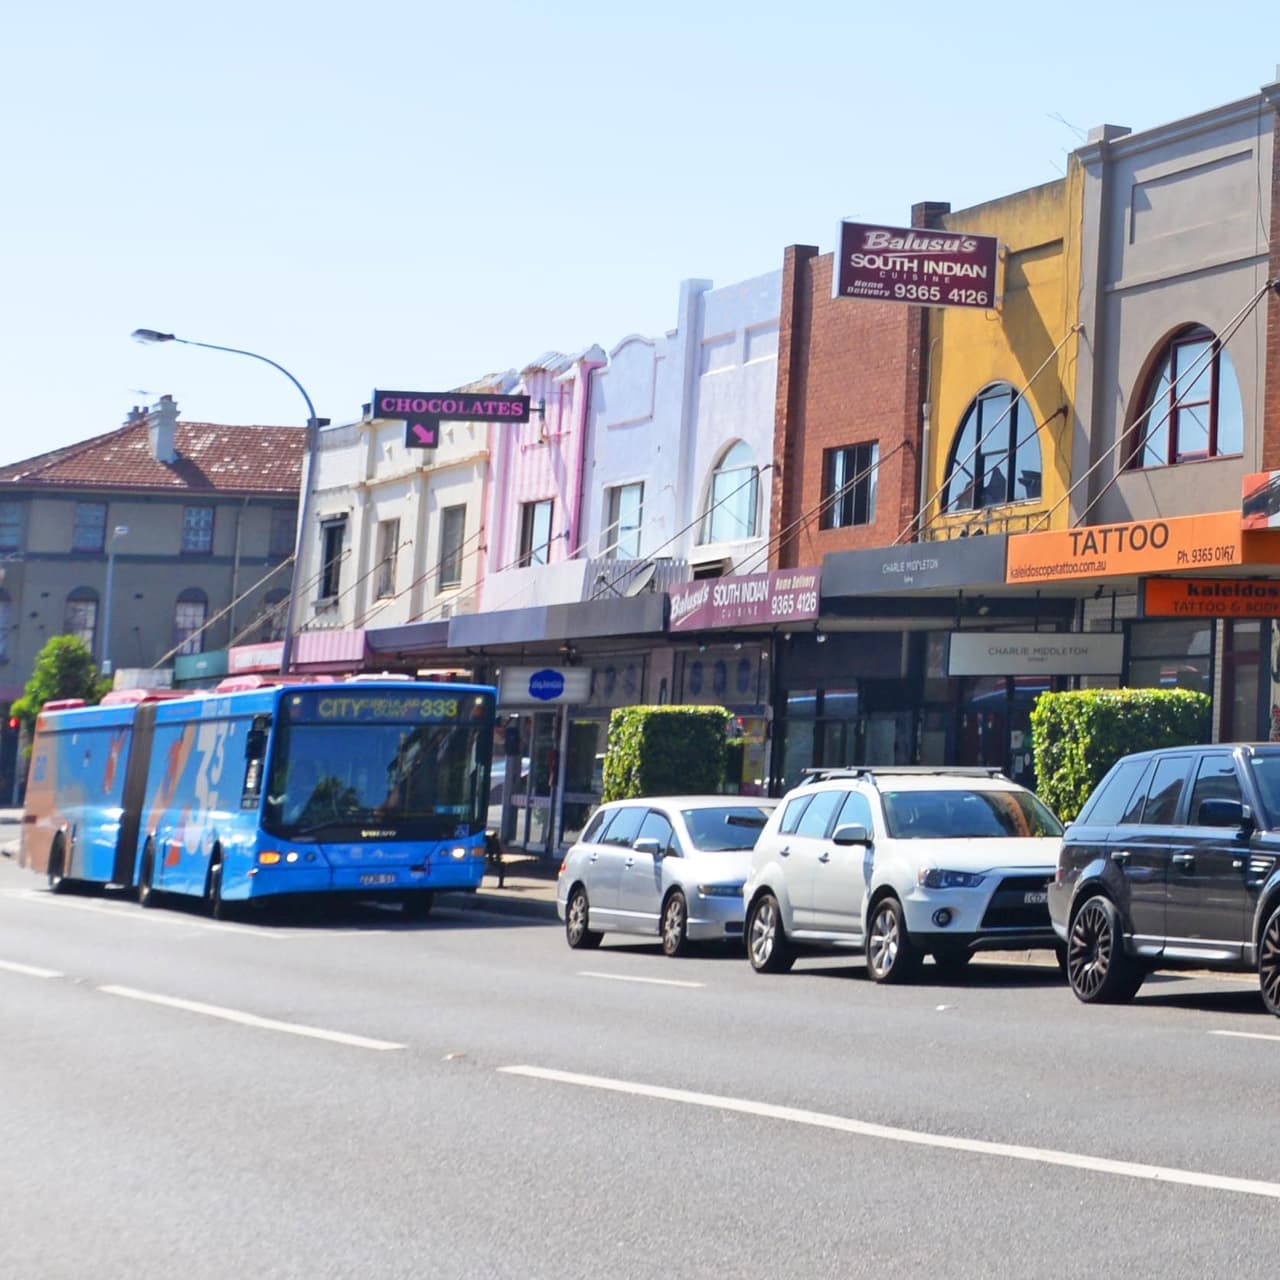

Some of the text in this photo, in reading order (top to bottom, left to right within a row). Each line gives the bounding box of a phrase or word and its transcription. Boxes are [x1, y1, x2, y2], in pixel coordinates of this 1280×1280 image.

[863, 231, 977, 253] Balusu's
[850, 253, 987, 278] SOUTH INDIAN
[880, 271, 950, 284] CUISINE
[894, 283, 941, 301] 9365
[948, 288, 988, 304] 4126
[381, 398, 524, 416] CHOCOLATES
[1069, 522, 1169, 556] TATTOO
[1191, 547, 1214, 563] 9365
[670, 583, 710, 621] Balusu's
[713, 580, 770, 606] SOUTH INDIAN
[771, 591, 817, 615] 9365 4126
[1172, 601, 1225, 613] TATTOO
[319, 698, 361, 718] CITY
[420, 698, 458, 717] 333
